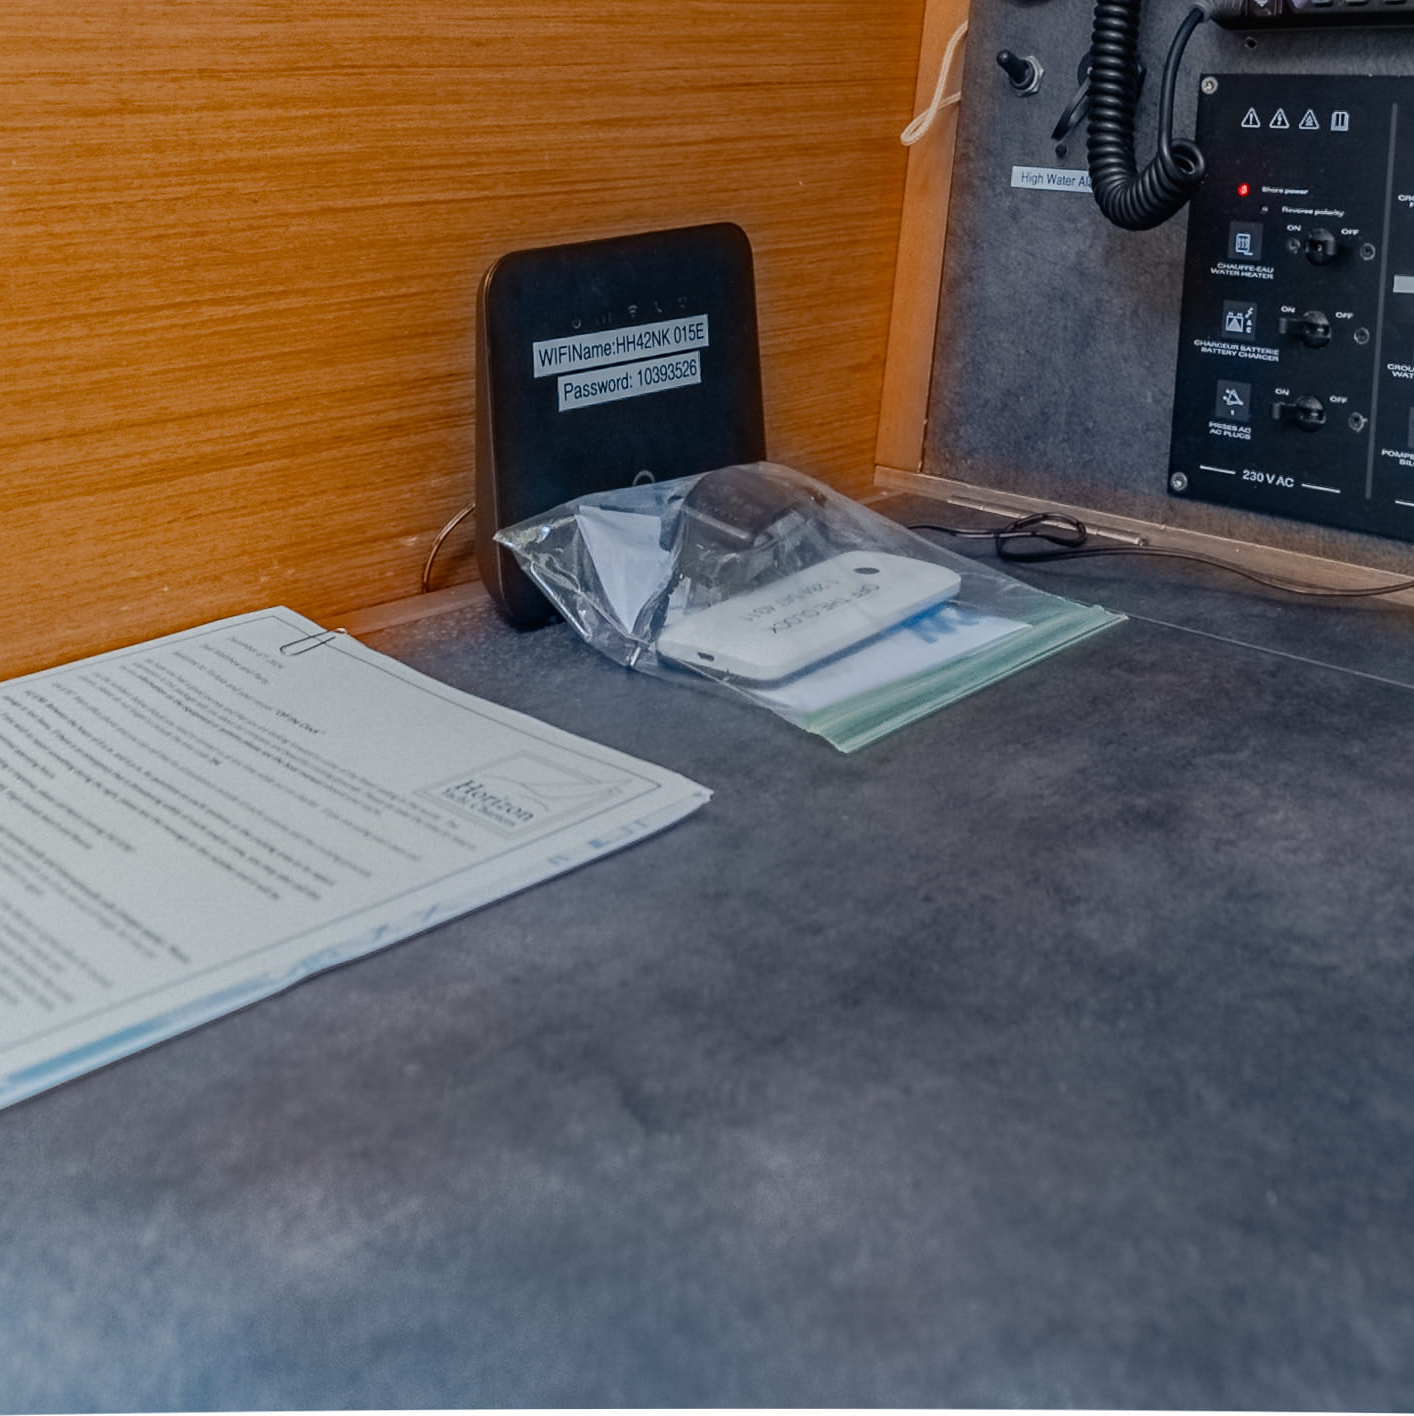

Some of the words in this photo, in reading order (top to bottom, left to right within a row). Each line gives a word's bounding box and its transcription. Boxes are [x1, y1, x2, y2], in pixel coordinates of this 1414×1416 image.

[1021, 172, 1044, 186] High
[1047, 174, 1075, 186] Water
[1262, 186, 1284, 194] Shore
[1284, 188, 1309, 196] power
[1282, 206, 1313, 215] Reverse
[1314, 209, 1345, 218] polarity
[538, 328, 671, 368] WIFIName:HH42NK
[673, 322, 705, 344] 015E
[563, 372, 633, 401] Password:
[637, 359, 697, 386] 10393526
[1381, 449, 1414, 460] POMPE
